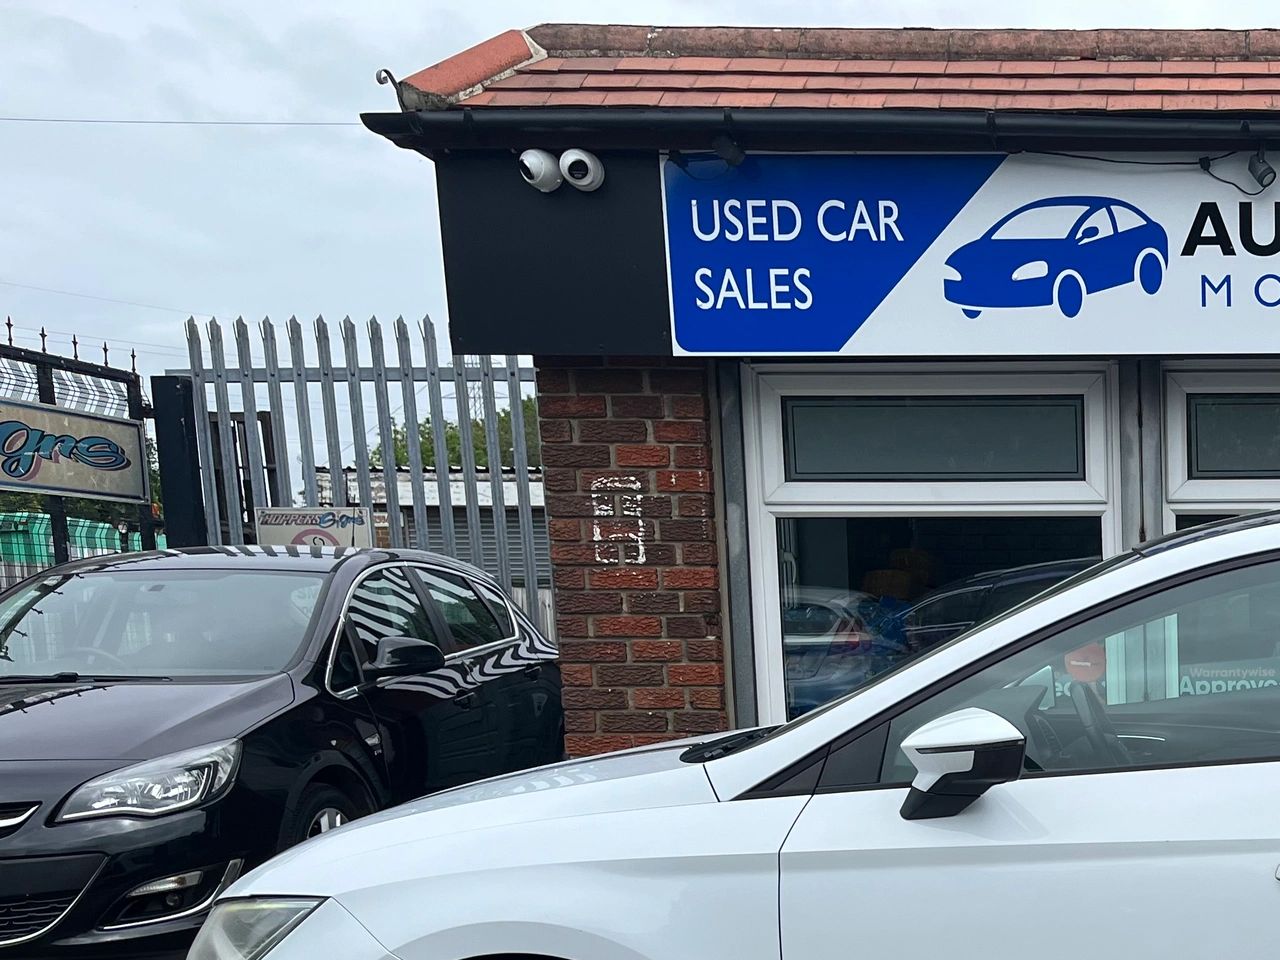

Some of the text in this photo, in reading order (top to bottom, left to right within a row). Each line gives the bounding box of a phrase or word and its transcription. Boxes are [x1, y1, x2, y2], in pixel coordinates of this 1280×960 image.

[690, 199, 905, 242] USED CAR
[694, 267, 813, 310] SALES
[1189, 667, 1277, 679] Warrantywise
